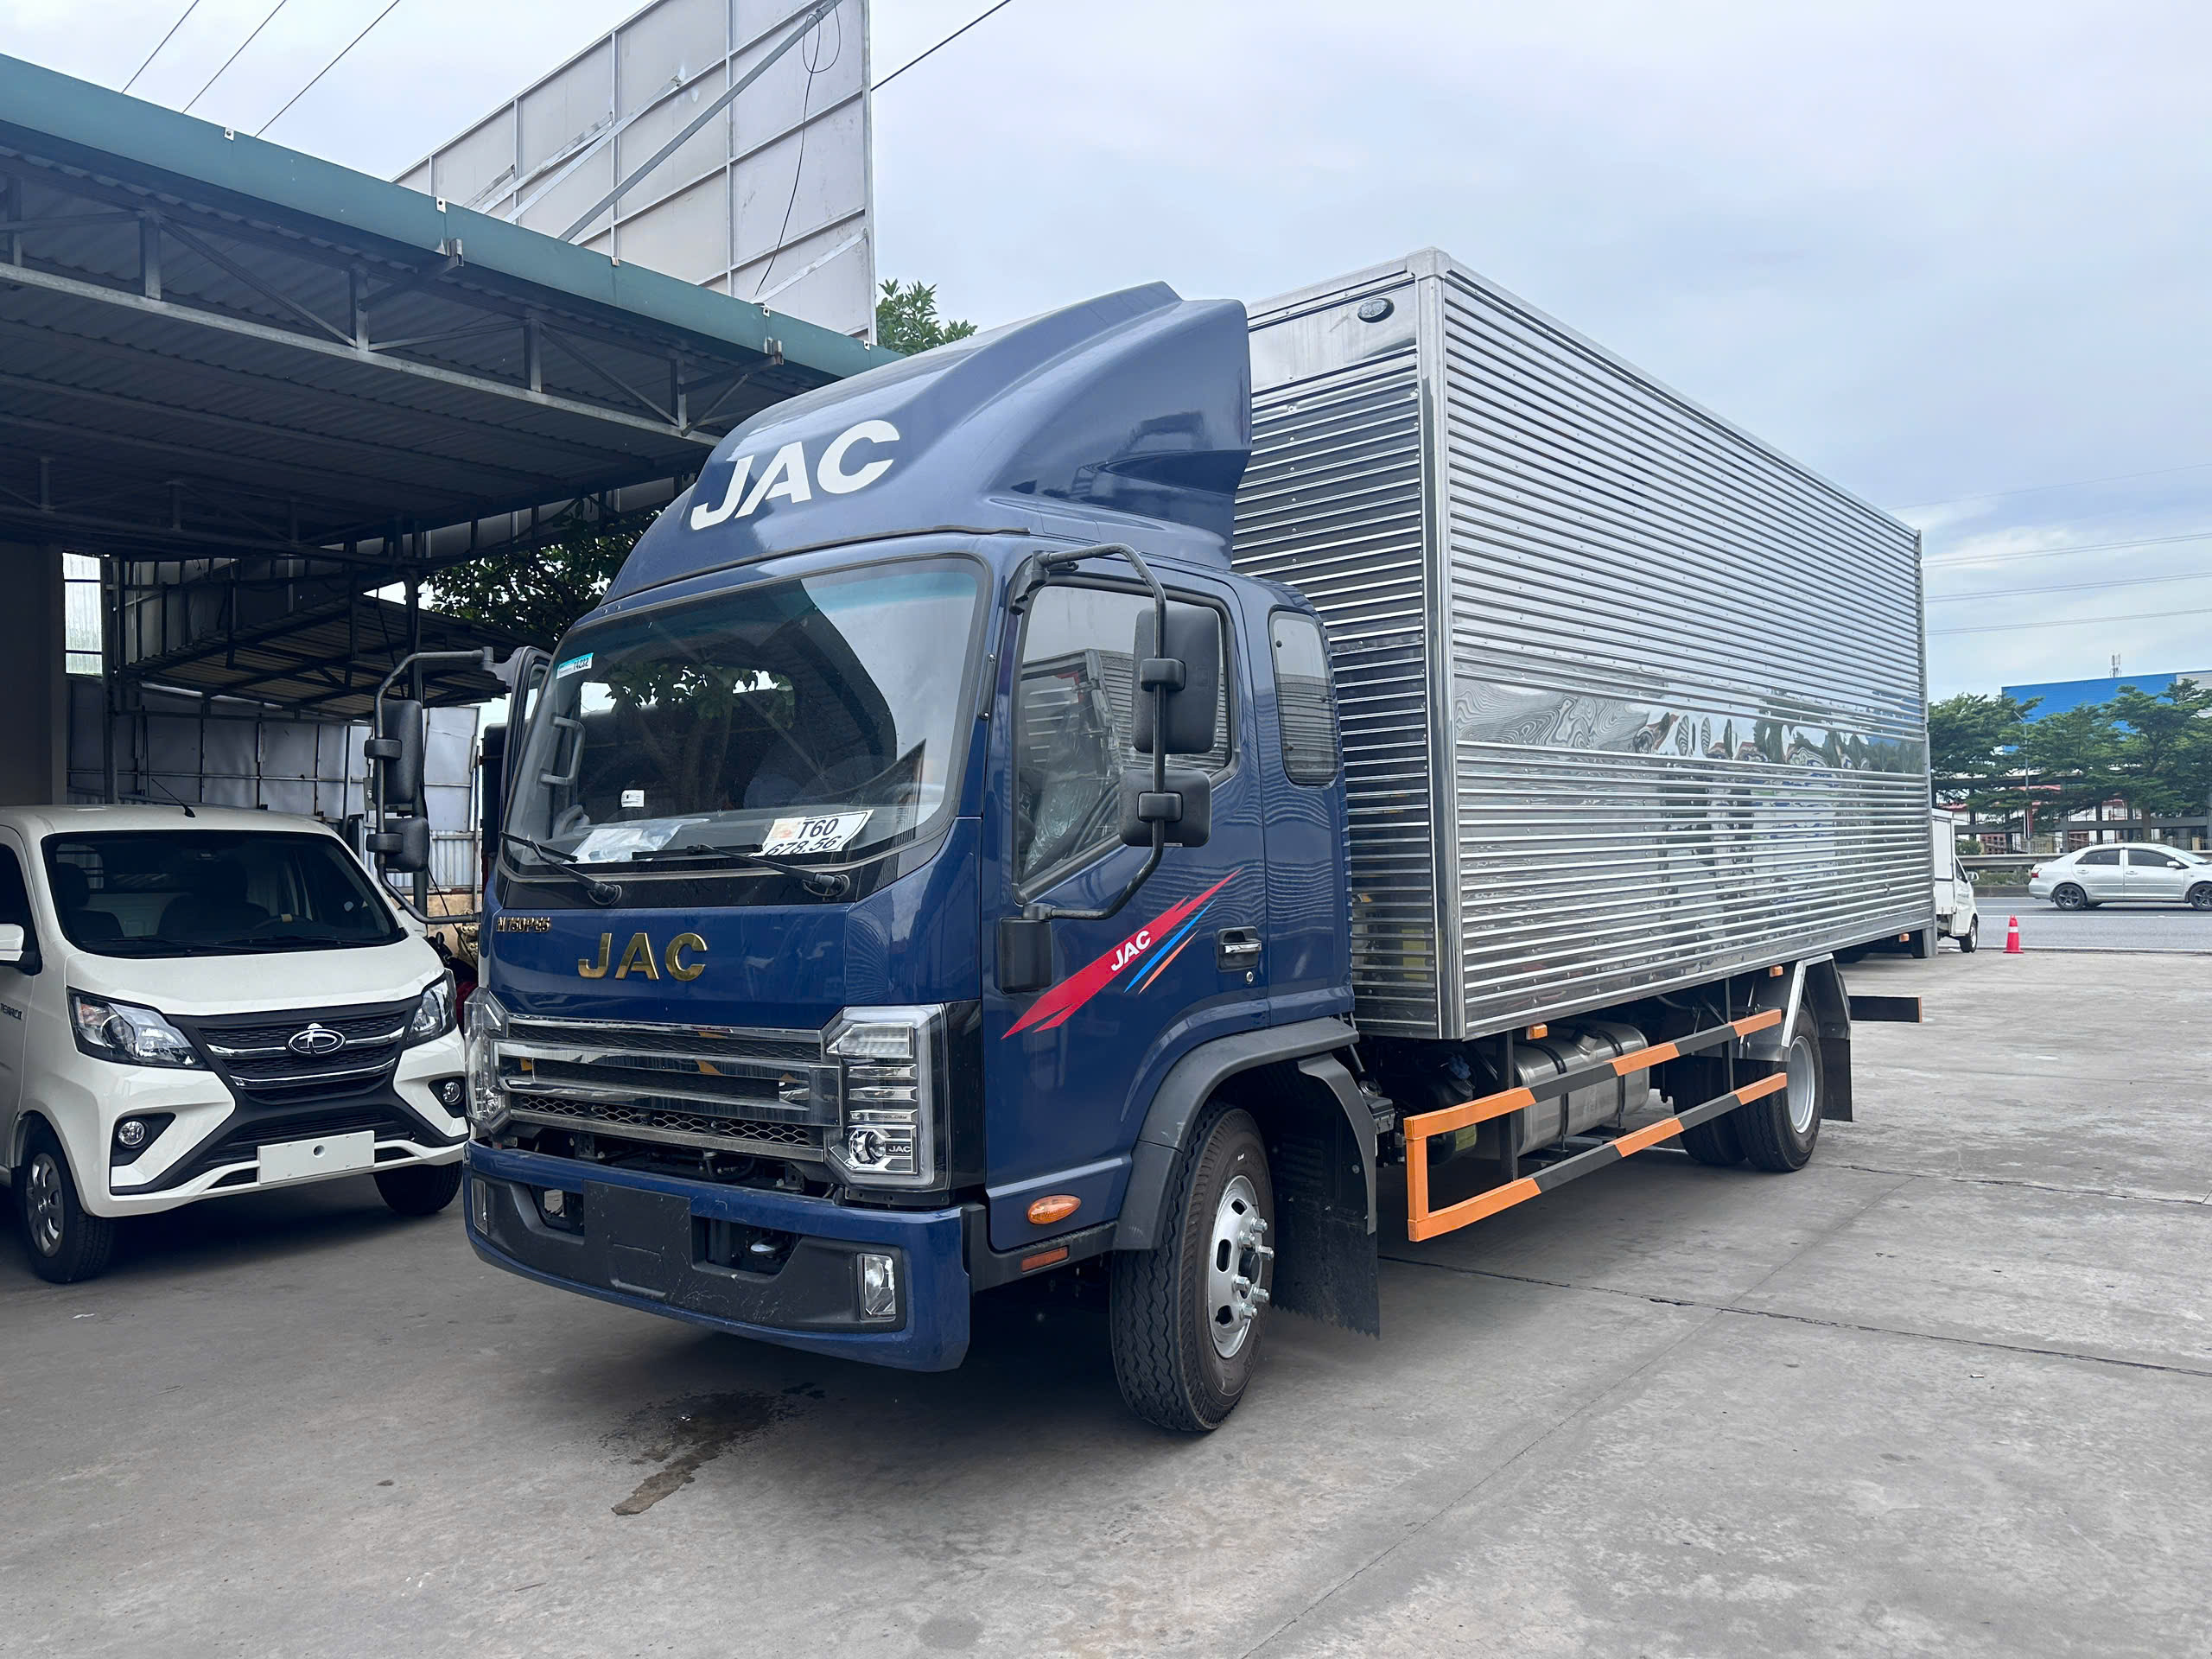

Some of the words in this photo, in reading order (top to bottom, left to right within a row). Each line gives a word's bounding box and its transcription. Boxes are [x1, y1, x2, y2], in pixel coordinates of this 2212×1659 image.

[690, 419, 900, 531] JAC
[798, 818, 839, 839] T60
[578, 932, 709, 982] JAC
[1110, 930, 1151, 971] JAC
[888, 1145, 911, 1154] JAC
